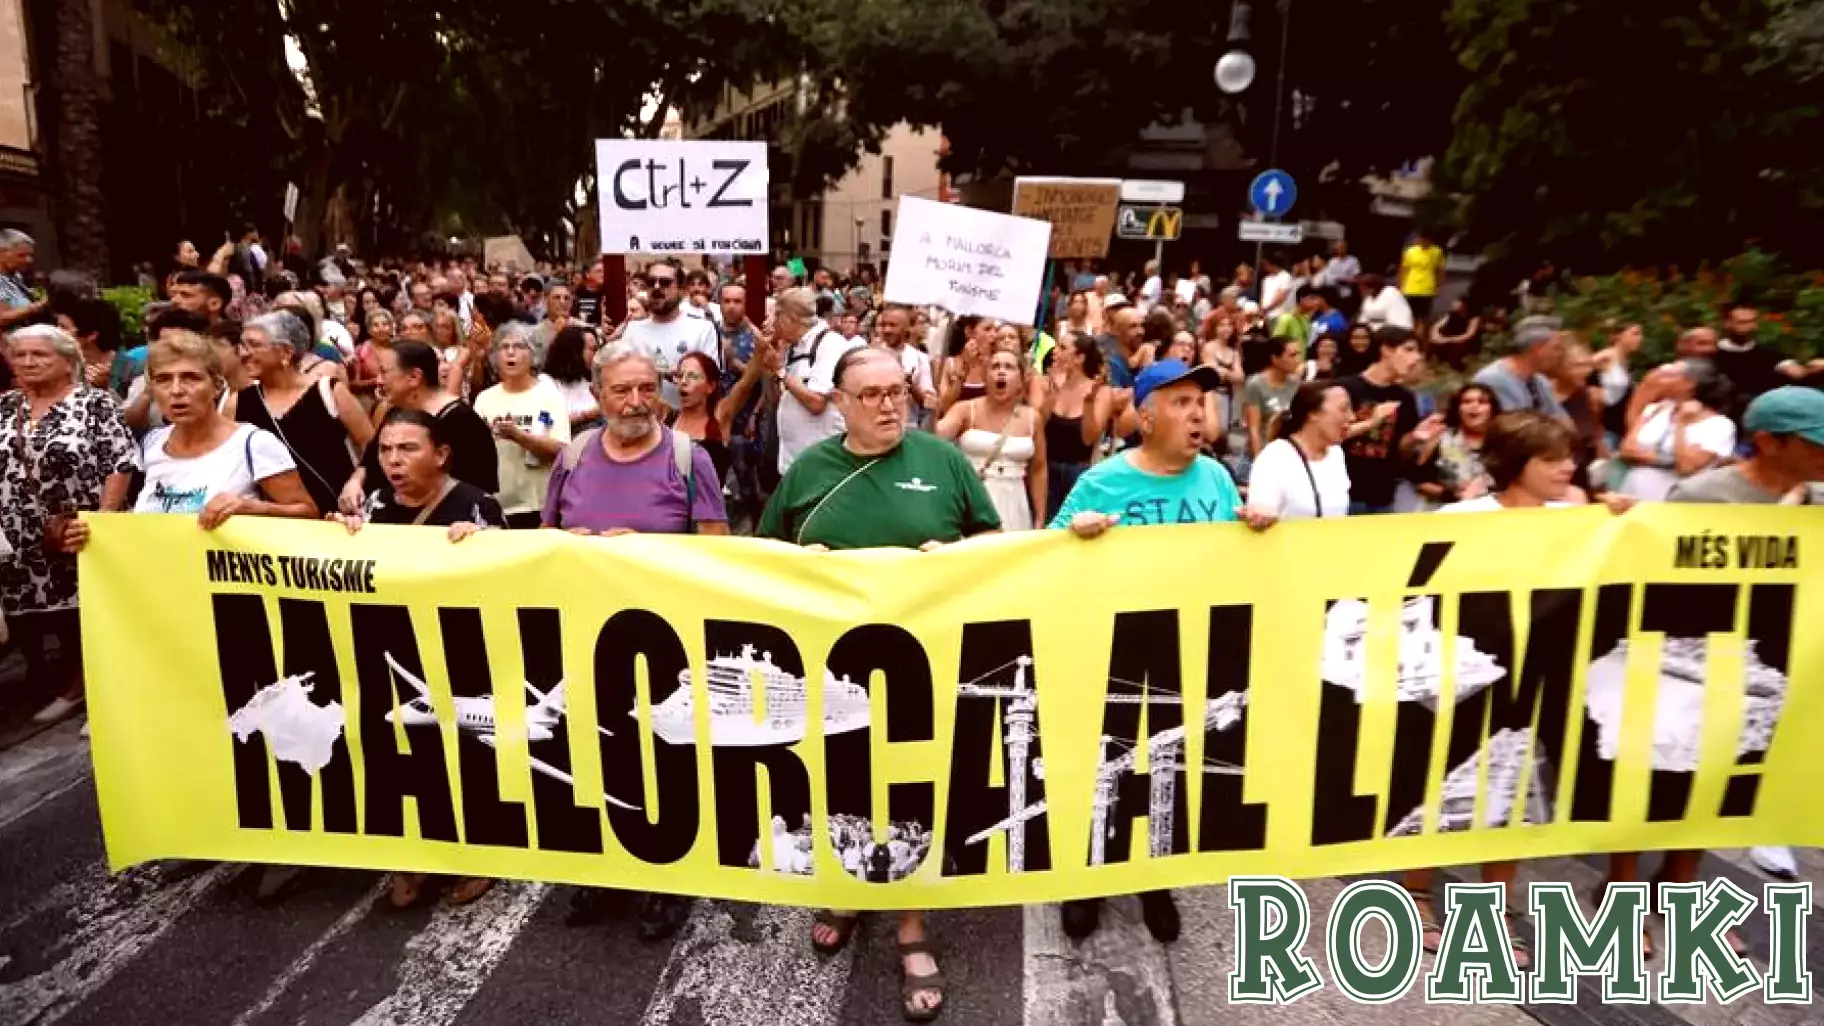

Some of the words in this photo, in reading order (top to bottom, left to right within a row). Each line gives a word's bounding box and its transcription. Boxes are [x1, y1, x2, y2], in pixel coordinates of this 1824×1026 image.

[613, 157, 754, 211] Ctrl+Z
[919, 231, 932, 244] A
[946, 235, 1012, 259] MALLORCA
[1126, 498, 1217, 526] STAY
[1674, 528, 1729, 568] MÉS
[1736, 535, 1798, 568] VIDA
[206, 549, 277, 586] MENYS
[277, 555, 376, 593] TURISME
[211, 593, 1053, 882] MALLORCA
[1086, 602, 1268, 868] AL
[1310, 541, 1798, 847] LÍMIT!
